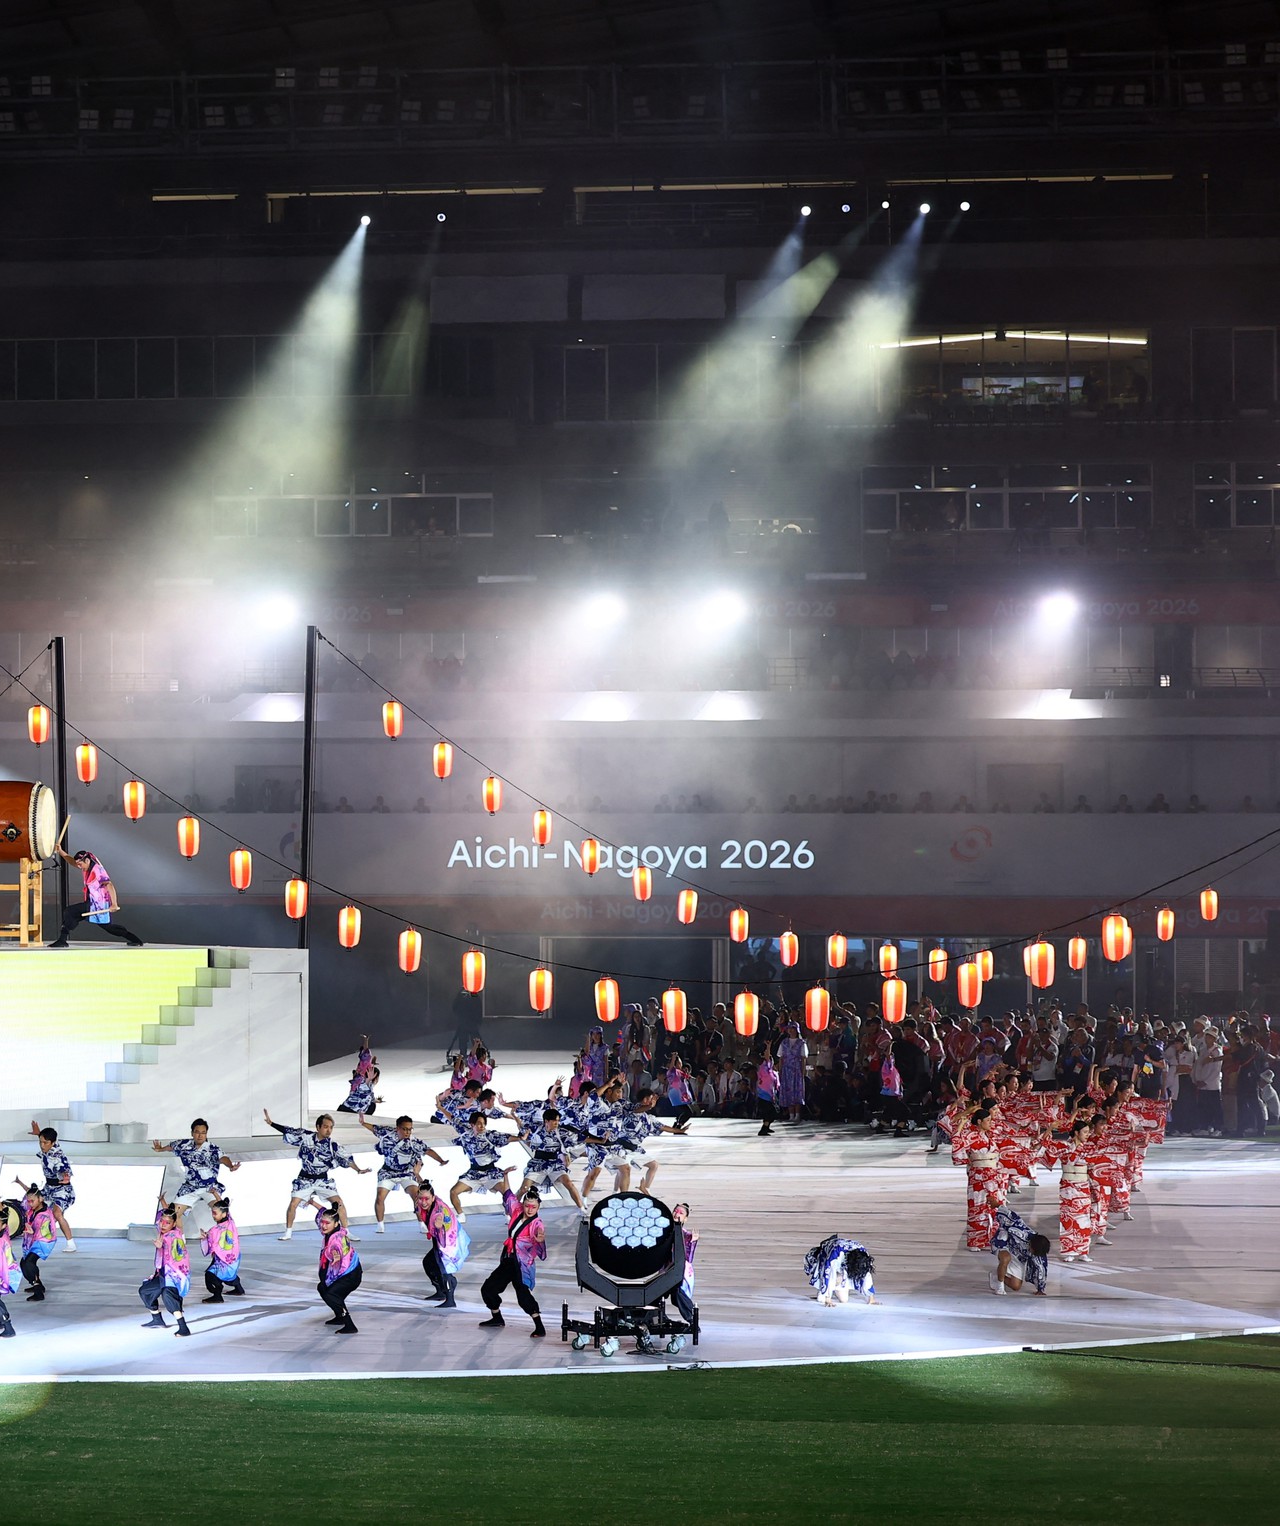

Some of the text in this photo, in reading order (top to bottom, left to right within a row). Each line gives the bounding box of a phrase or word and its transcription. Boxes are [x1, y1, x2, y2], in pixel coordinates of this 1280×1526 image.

[1146, 599, 1200, 615] 2026
[447, 836, 814, 878] Aichi-Nagoya 2026
[540, 900, 736, 924] Aichi-Nagoy 202
